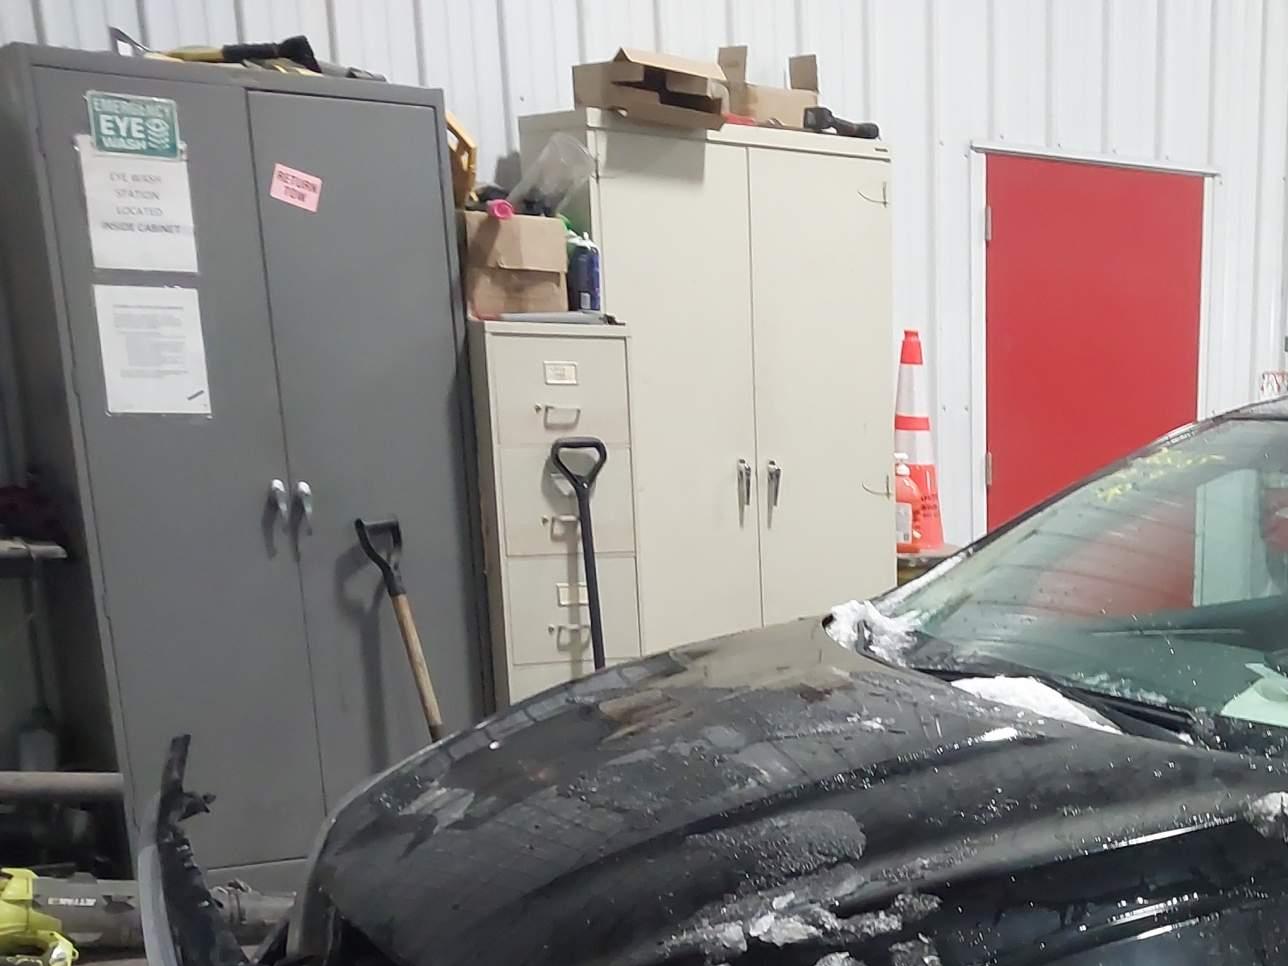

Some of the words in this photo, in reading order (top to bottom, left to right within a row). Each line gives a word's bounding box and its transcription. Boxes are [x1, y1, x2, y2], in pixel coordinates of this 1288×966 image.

[100, 114, 146, 139] EYE
[101, 136, 147, 151] WASH
[277, 170, 317, 193] RETURN
[114, 188, 161, 201] STATION
[284, 185, 305, 202] TOW
[115, 205, 164, 217] LOCATED
[101, 221, 135, 232] INSIDE
[137, 222, 181, 234] CABINET
